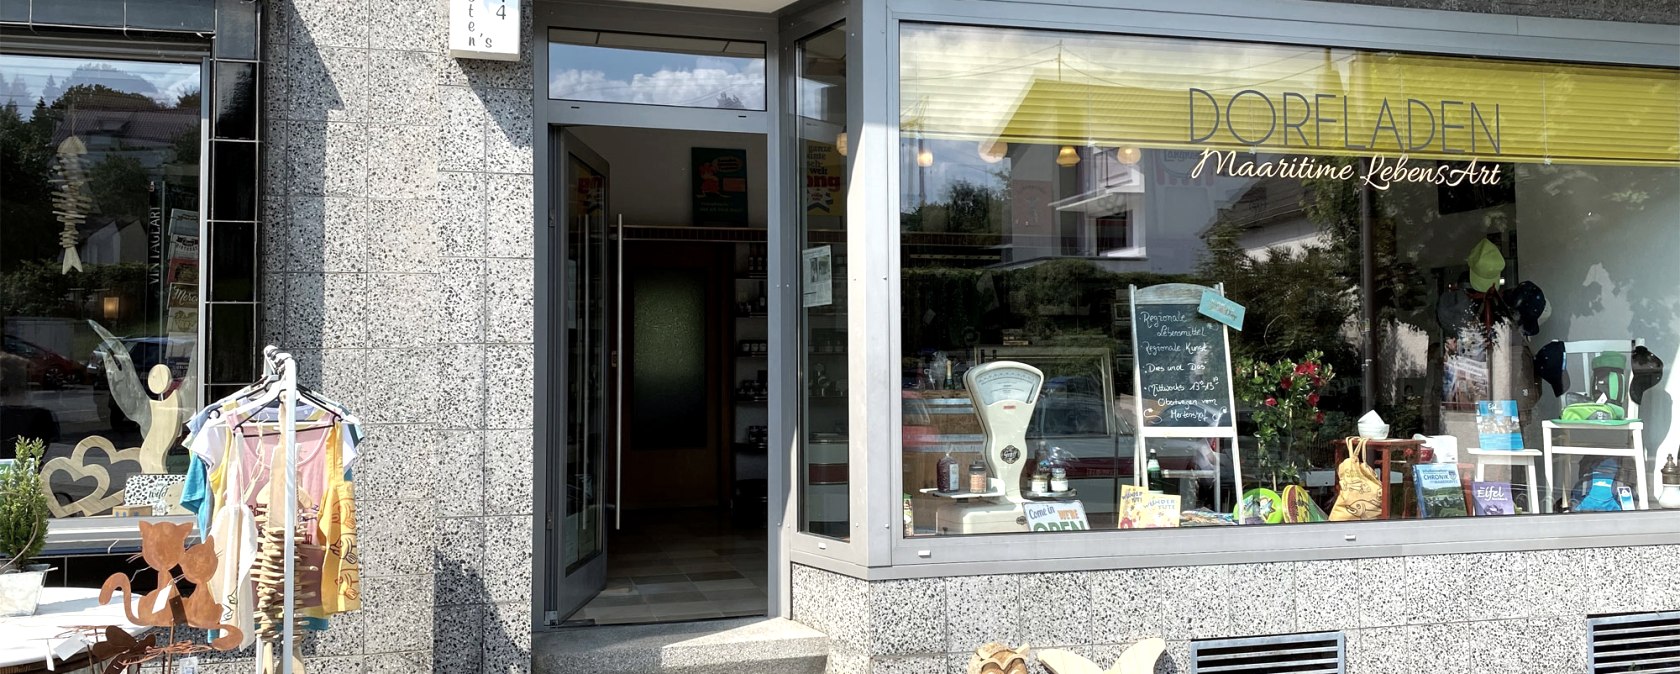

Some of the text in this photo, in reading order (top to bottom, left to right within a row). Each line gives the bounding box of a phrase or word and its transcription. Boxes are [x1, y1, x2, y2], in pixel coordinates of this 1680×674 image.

[1189, 87, 1501, 155] DORFLADEN
[1191, 147, 1501, 190] Maaritime LebensArt
[1140, 310, 1188, 329] Regionale
[1156, 325, 1207, 337] Lebensmittel
[1143, 341, 1208, 356] Regionale Kunst
[1168, 364, 1185, 372] und
[1147, 382, 1185, 397] Mittwochs
[1477, 486, 1505, 501] Eifel
[1143, 499, 1176, 509] WUNDER
[1028, 504, 1055, 520] Come in
